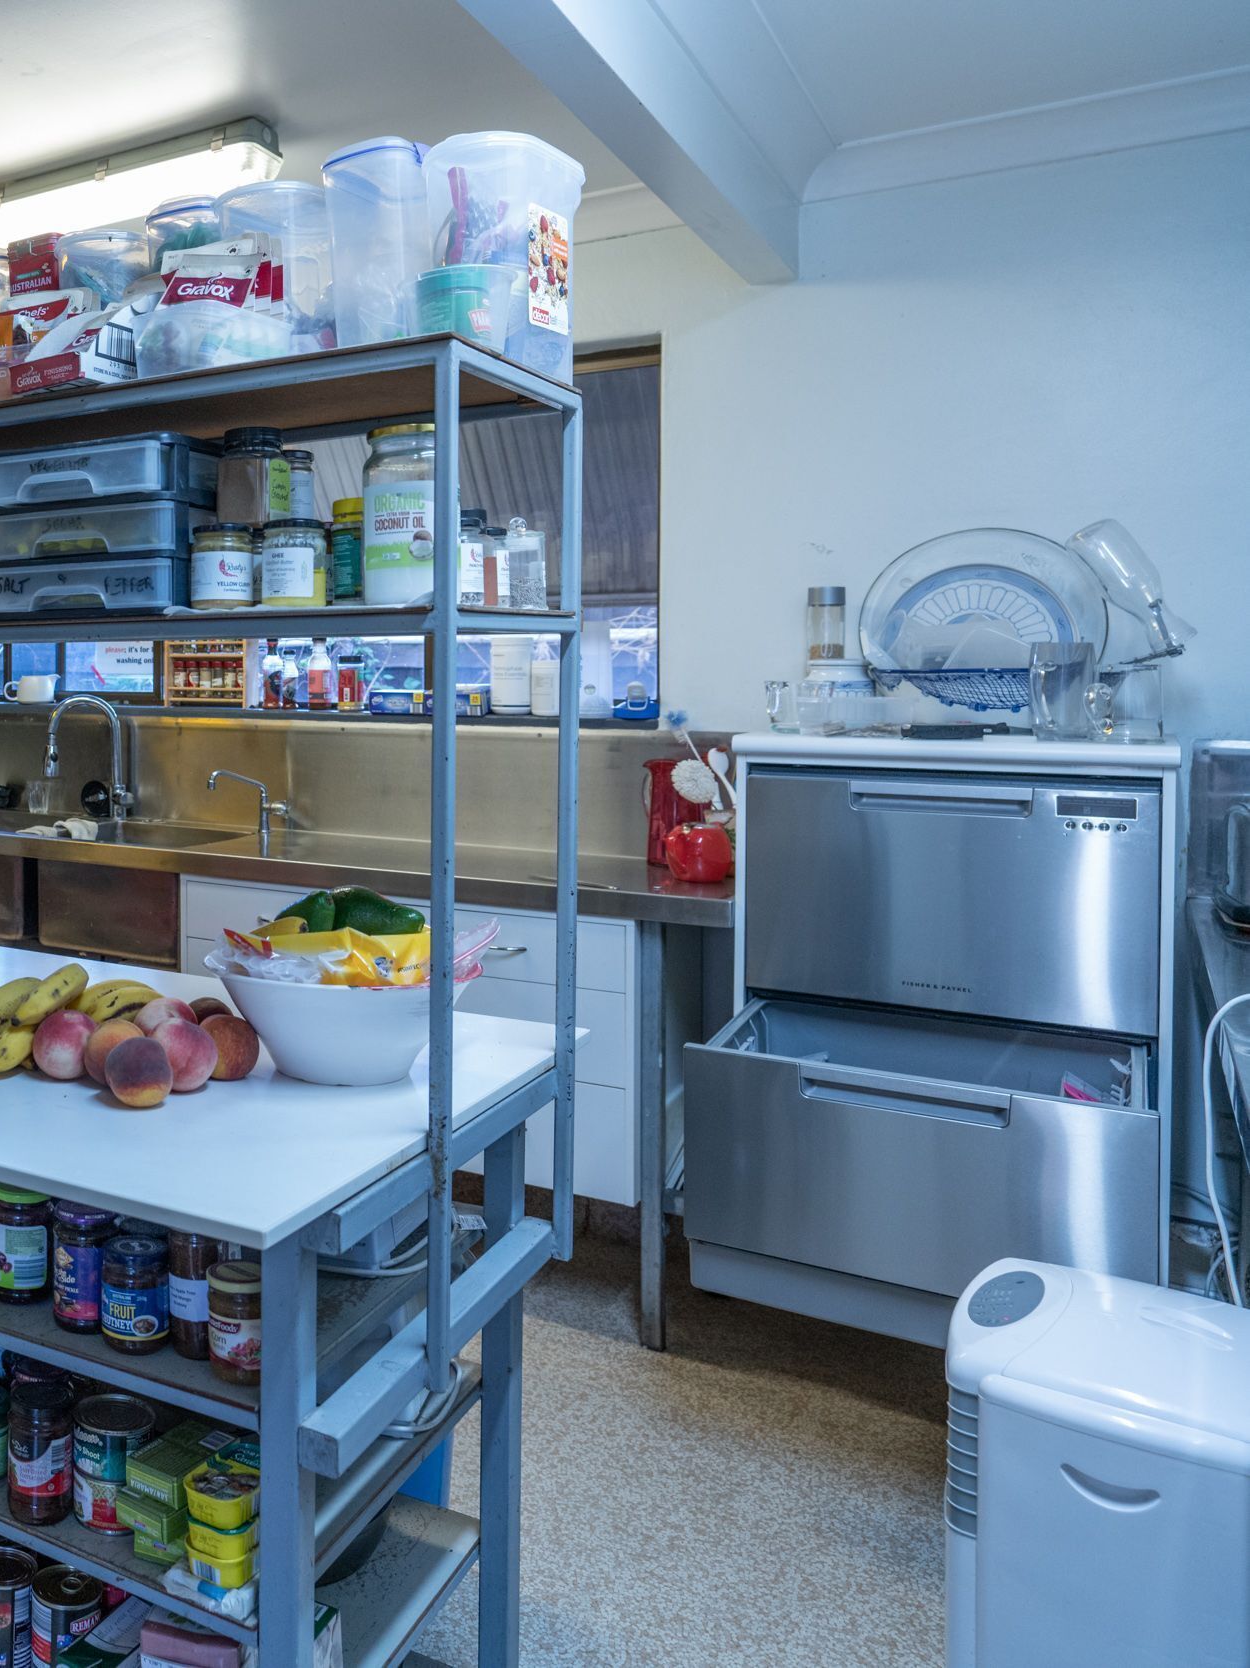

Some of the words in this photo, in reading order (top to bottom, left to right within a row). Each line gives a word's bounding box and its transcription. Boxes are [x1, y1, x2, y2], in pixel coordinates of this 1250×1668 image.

[177, 282, 234, 300] Gravox
[374, 491, 426, 513] ORGANIC
[374, 517, 409, 531] COCONUT
[412, 516, 426, 529] OIL
[116, 657, 142, 665] washing
[901, 980, 931, 989] FISHER
[941, 984, 973, 993] PAYKEL
[109, 1302, 136, 1319] FRUIT
[211, 1331, 227, 1345] Corn
[82, 1446, 100, 1460] Shoot
